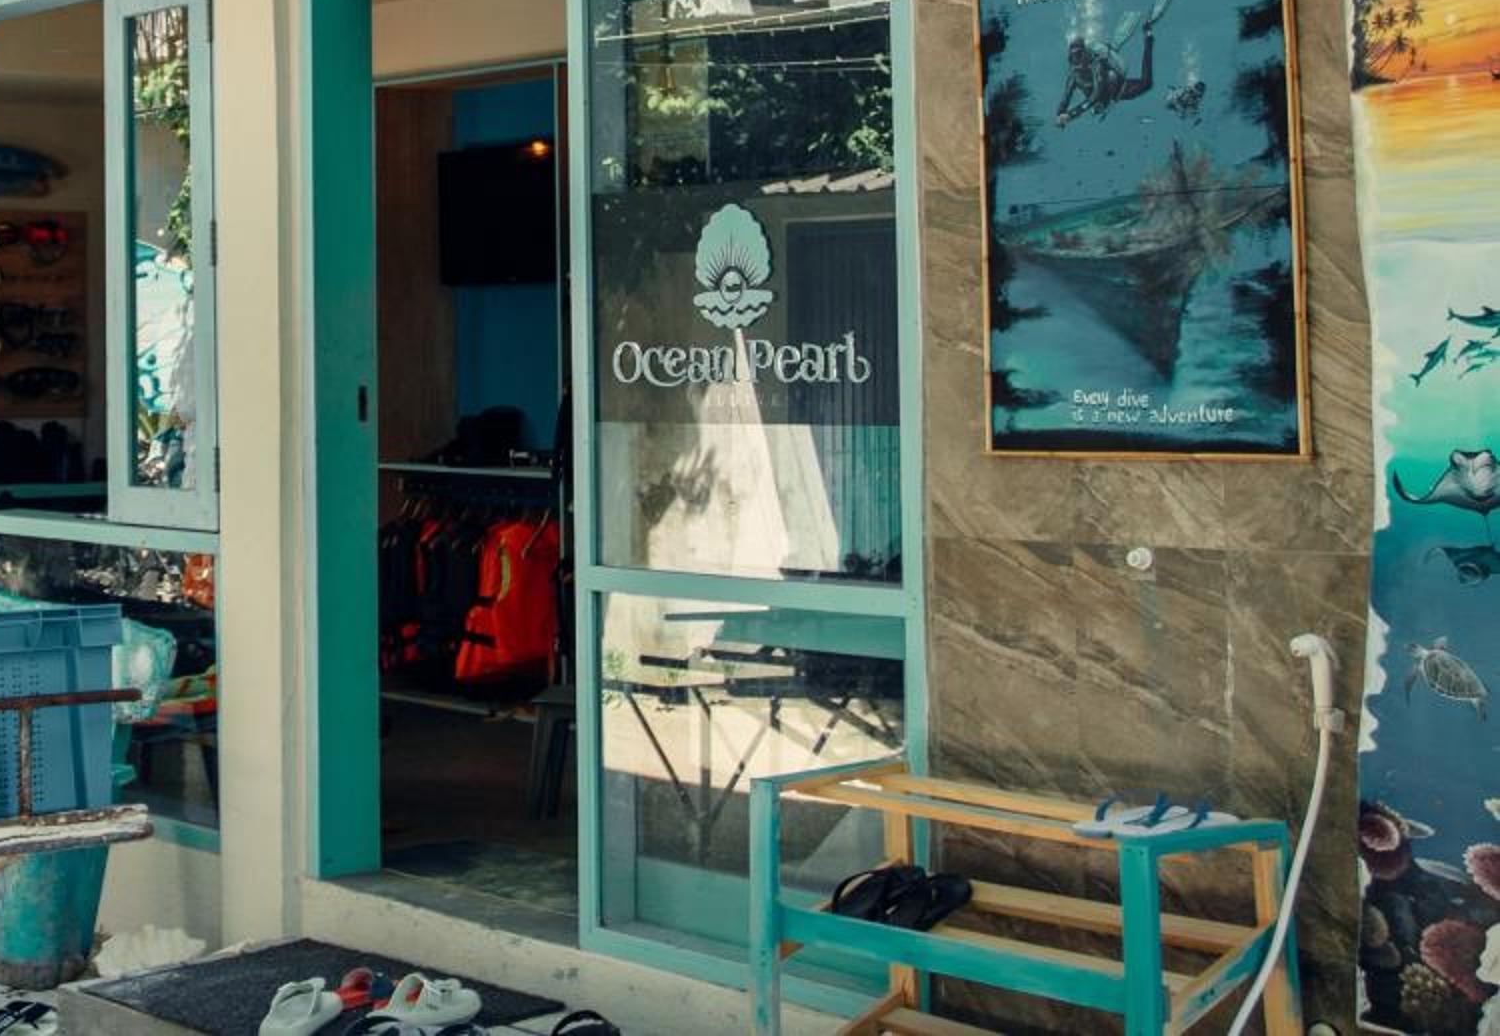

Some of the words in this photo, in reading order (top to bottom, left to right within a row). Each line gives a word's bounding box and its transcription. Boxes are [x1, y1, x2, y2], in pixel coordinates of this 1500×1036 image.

[612, 340, 738, 388] Ocean
[746, 330, 872, 384] Pearl
[1117, 387, 1149, 408] dive
[1107, 410, 1140, 423] new
[1149, 404, 1234, 423] adventure
